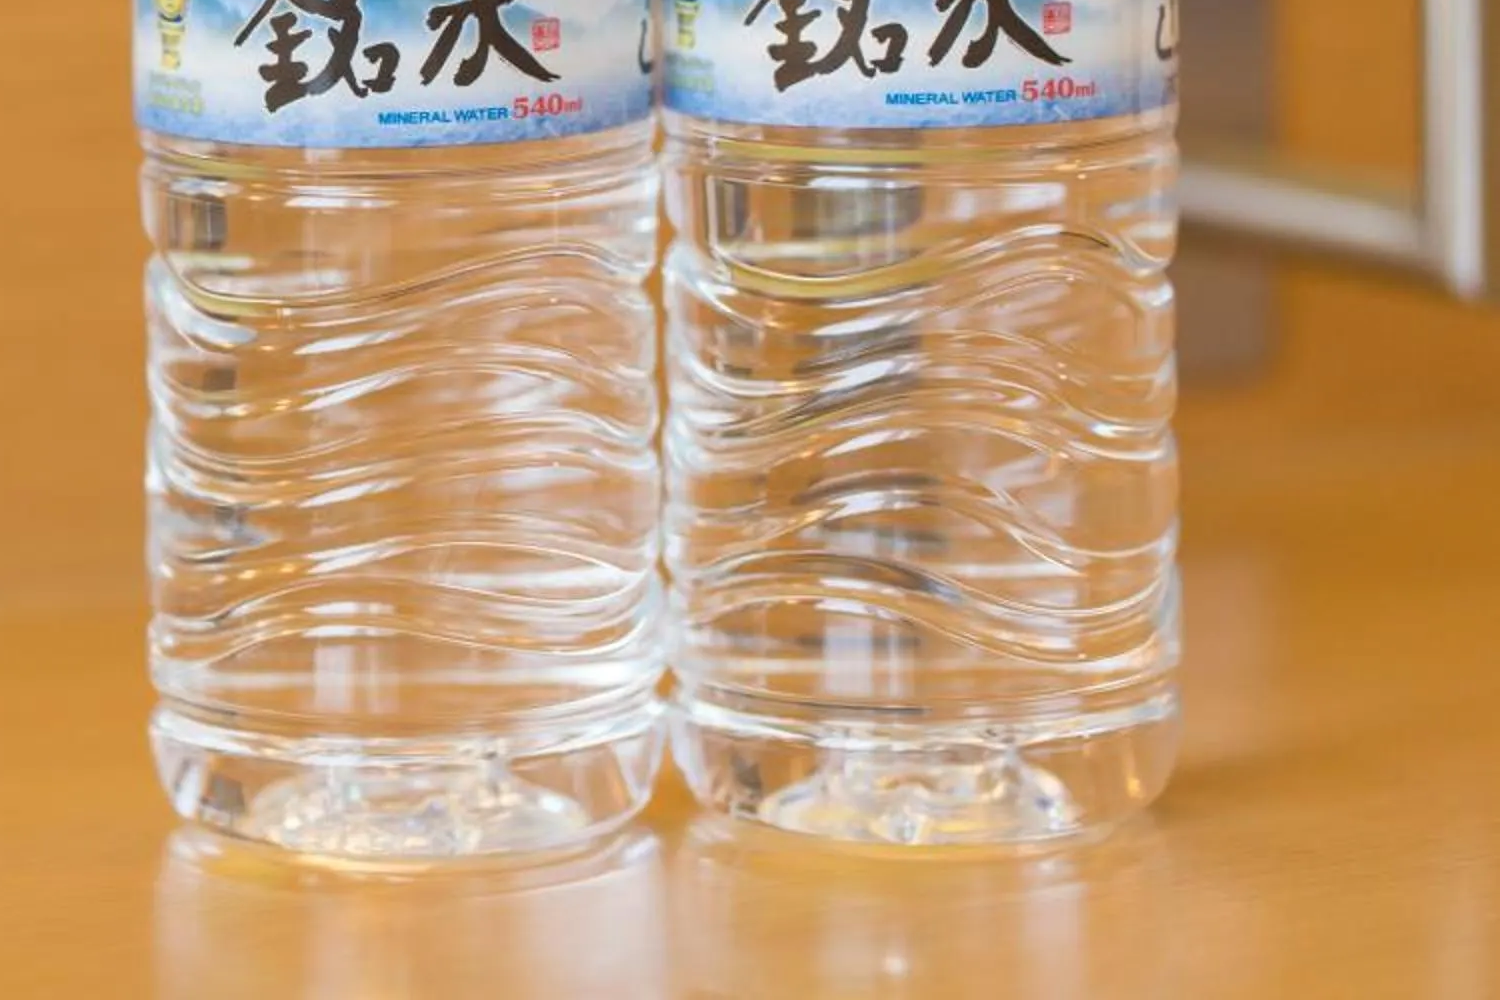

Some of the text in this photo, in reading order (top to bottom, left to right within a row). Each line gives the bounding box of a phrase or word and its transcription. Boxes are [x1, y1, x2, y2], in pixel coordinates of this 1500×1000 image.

[885, 76, 1095, 106] MINERAL WATER 540ml
[377, 92, 583, 126] MINERAL WATER 540ml
